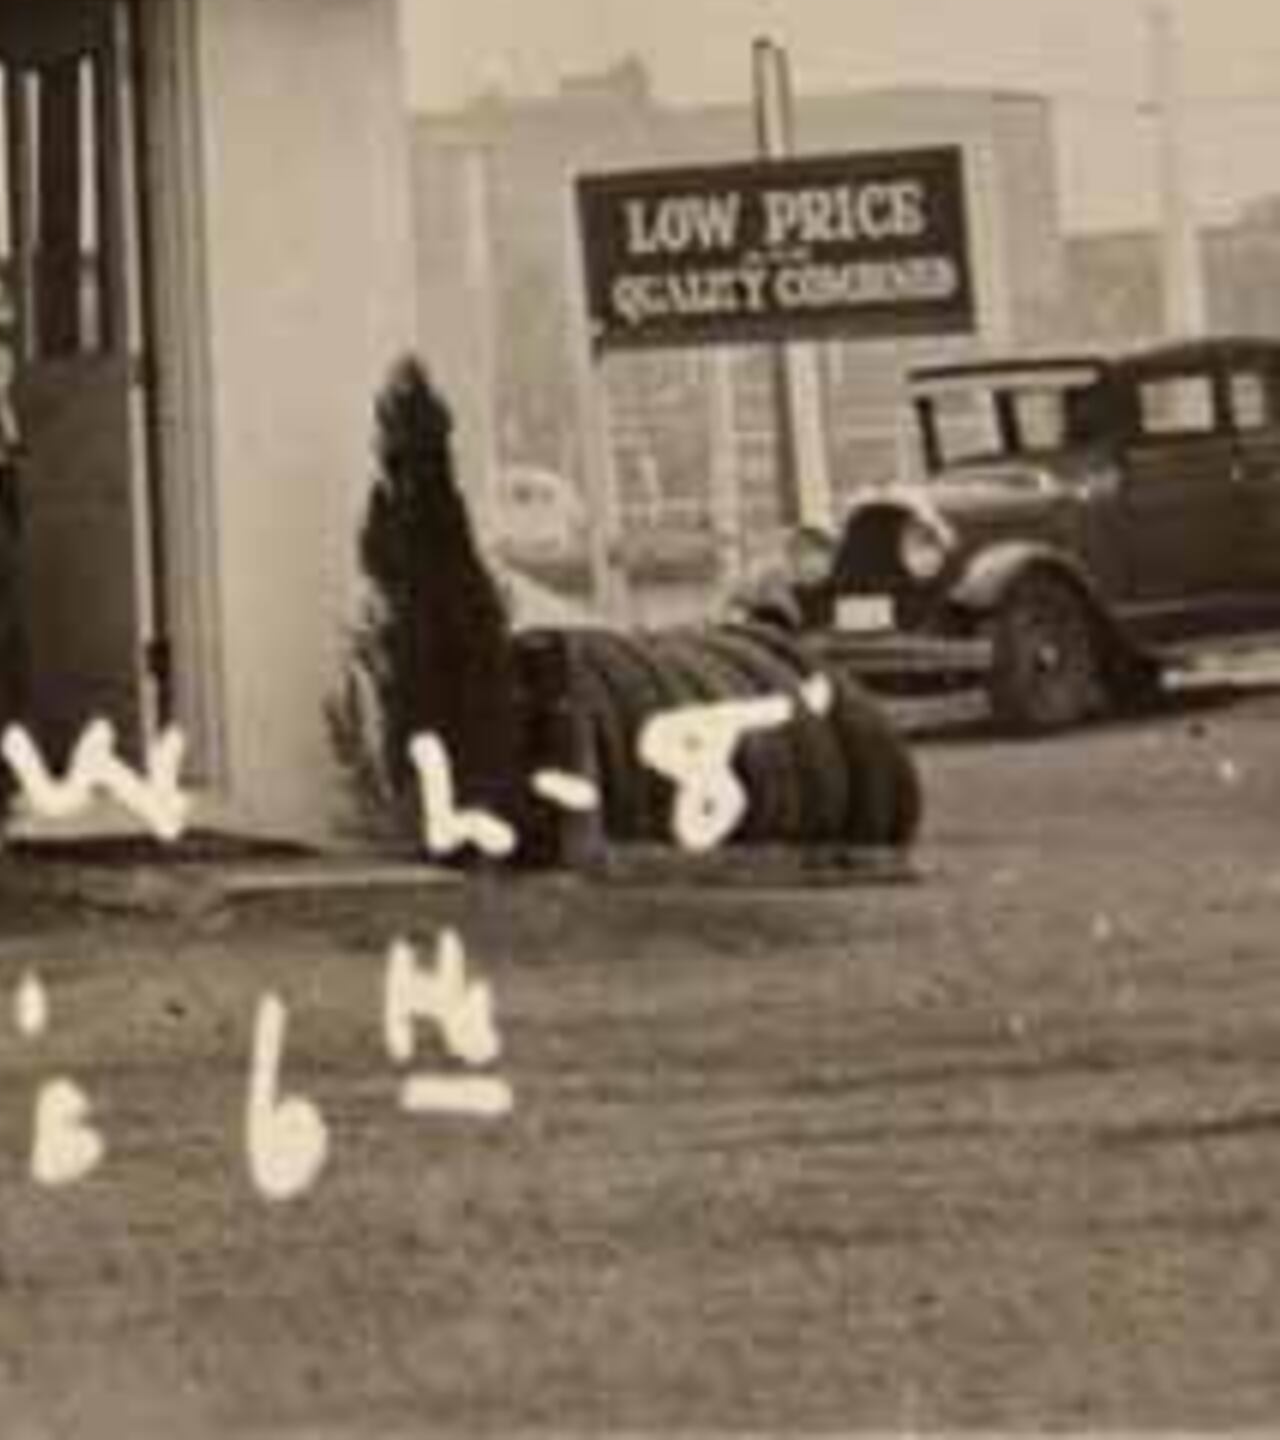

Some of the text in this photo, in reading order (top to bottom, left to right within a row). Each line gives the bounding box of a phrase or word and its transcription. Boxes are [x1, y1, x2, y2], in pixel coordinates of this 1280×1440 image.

[624, 182, 926, 256] LOW PRICE
[612, 264, 768, 326] QUALITY
